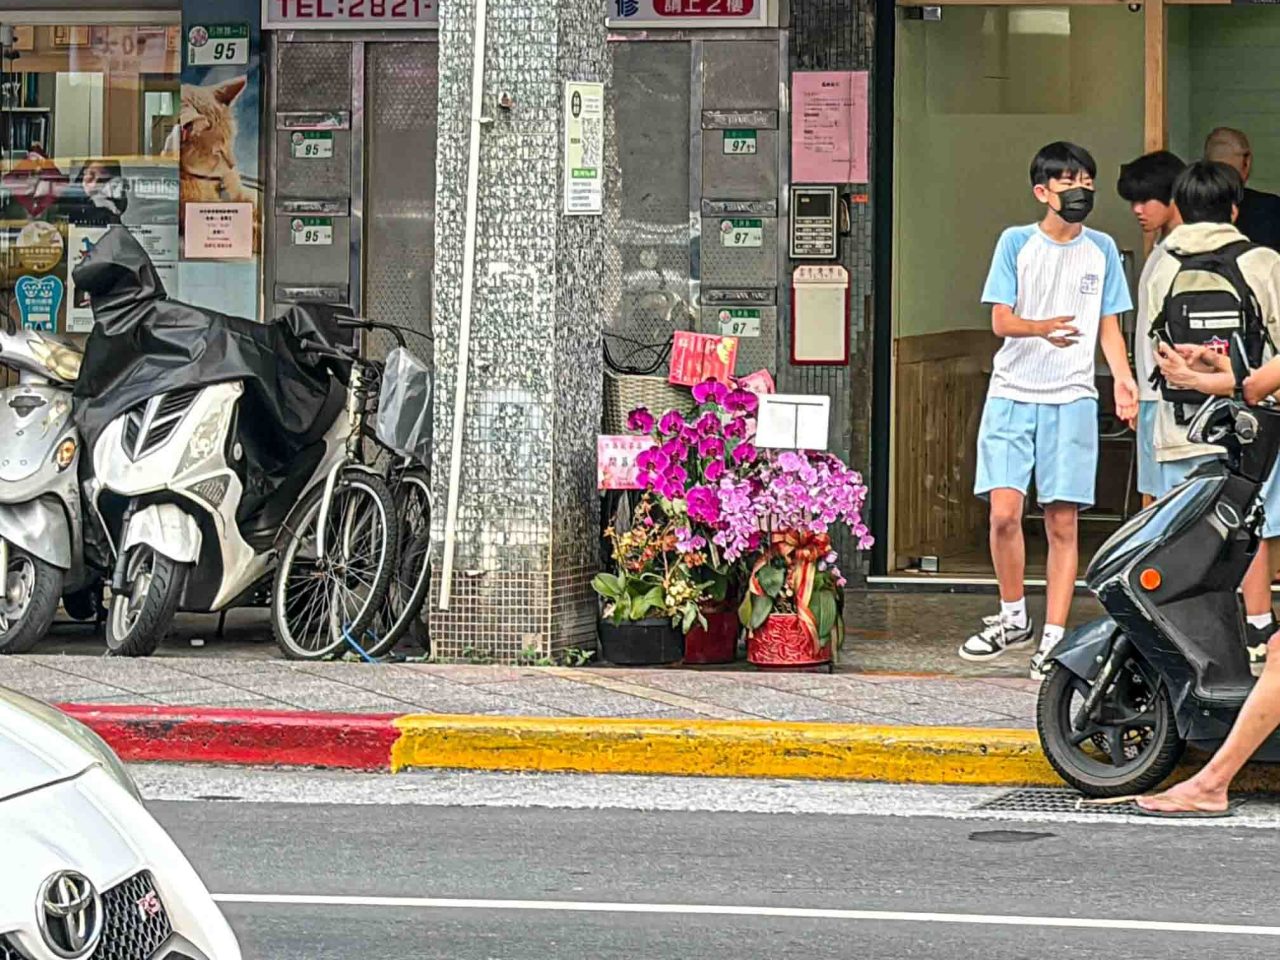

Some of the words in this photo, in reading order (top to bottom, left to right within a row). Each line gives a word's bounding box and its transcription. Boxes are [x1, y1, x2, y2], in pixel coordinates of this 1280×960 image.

[213, 42, 237, 61] 95
[305, 143, 319, 156] 95
[732, 140, 747, 153] 97
[305, 230, 319, 243] 95
[734, 232, 749, 244] 97
[732, 323, 747, 335] 97
